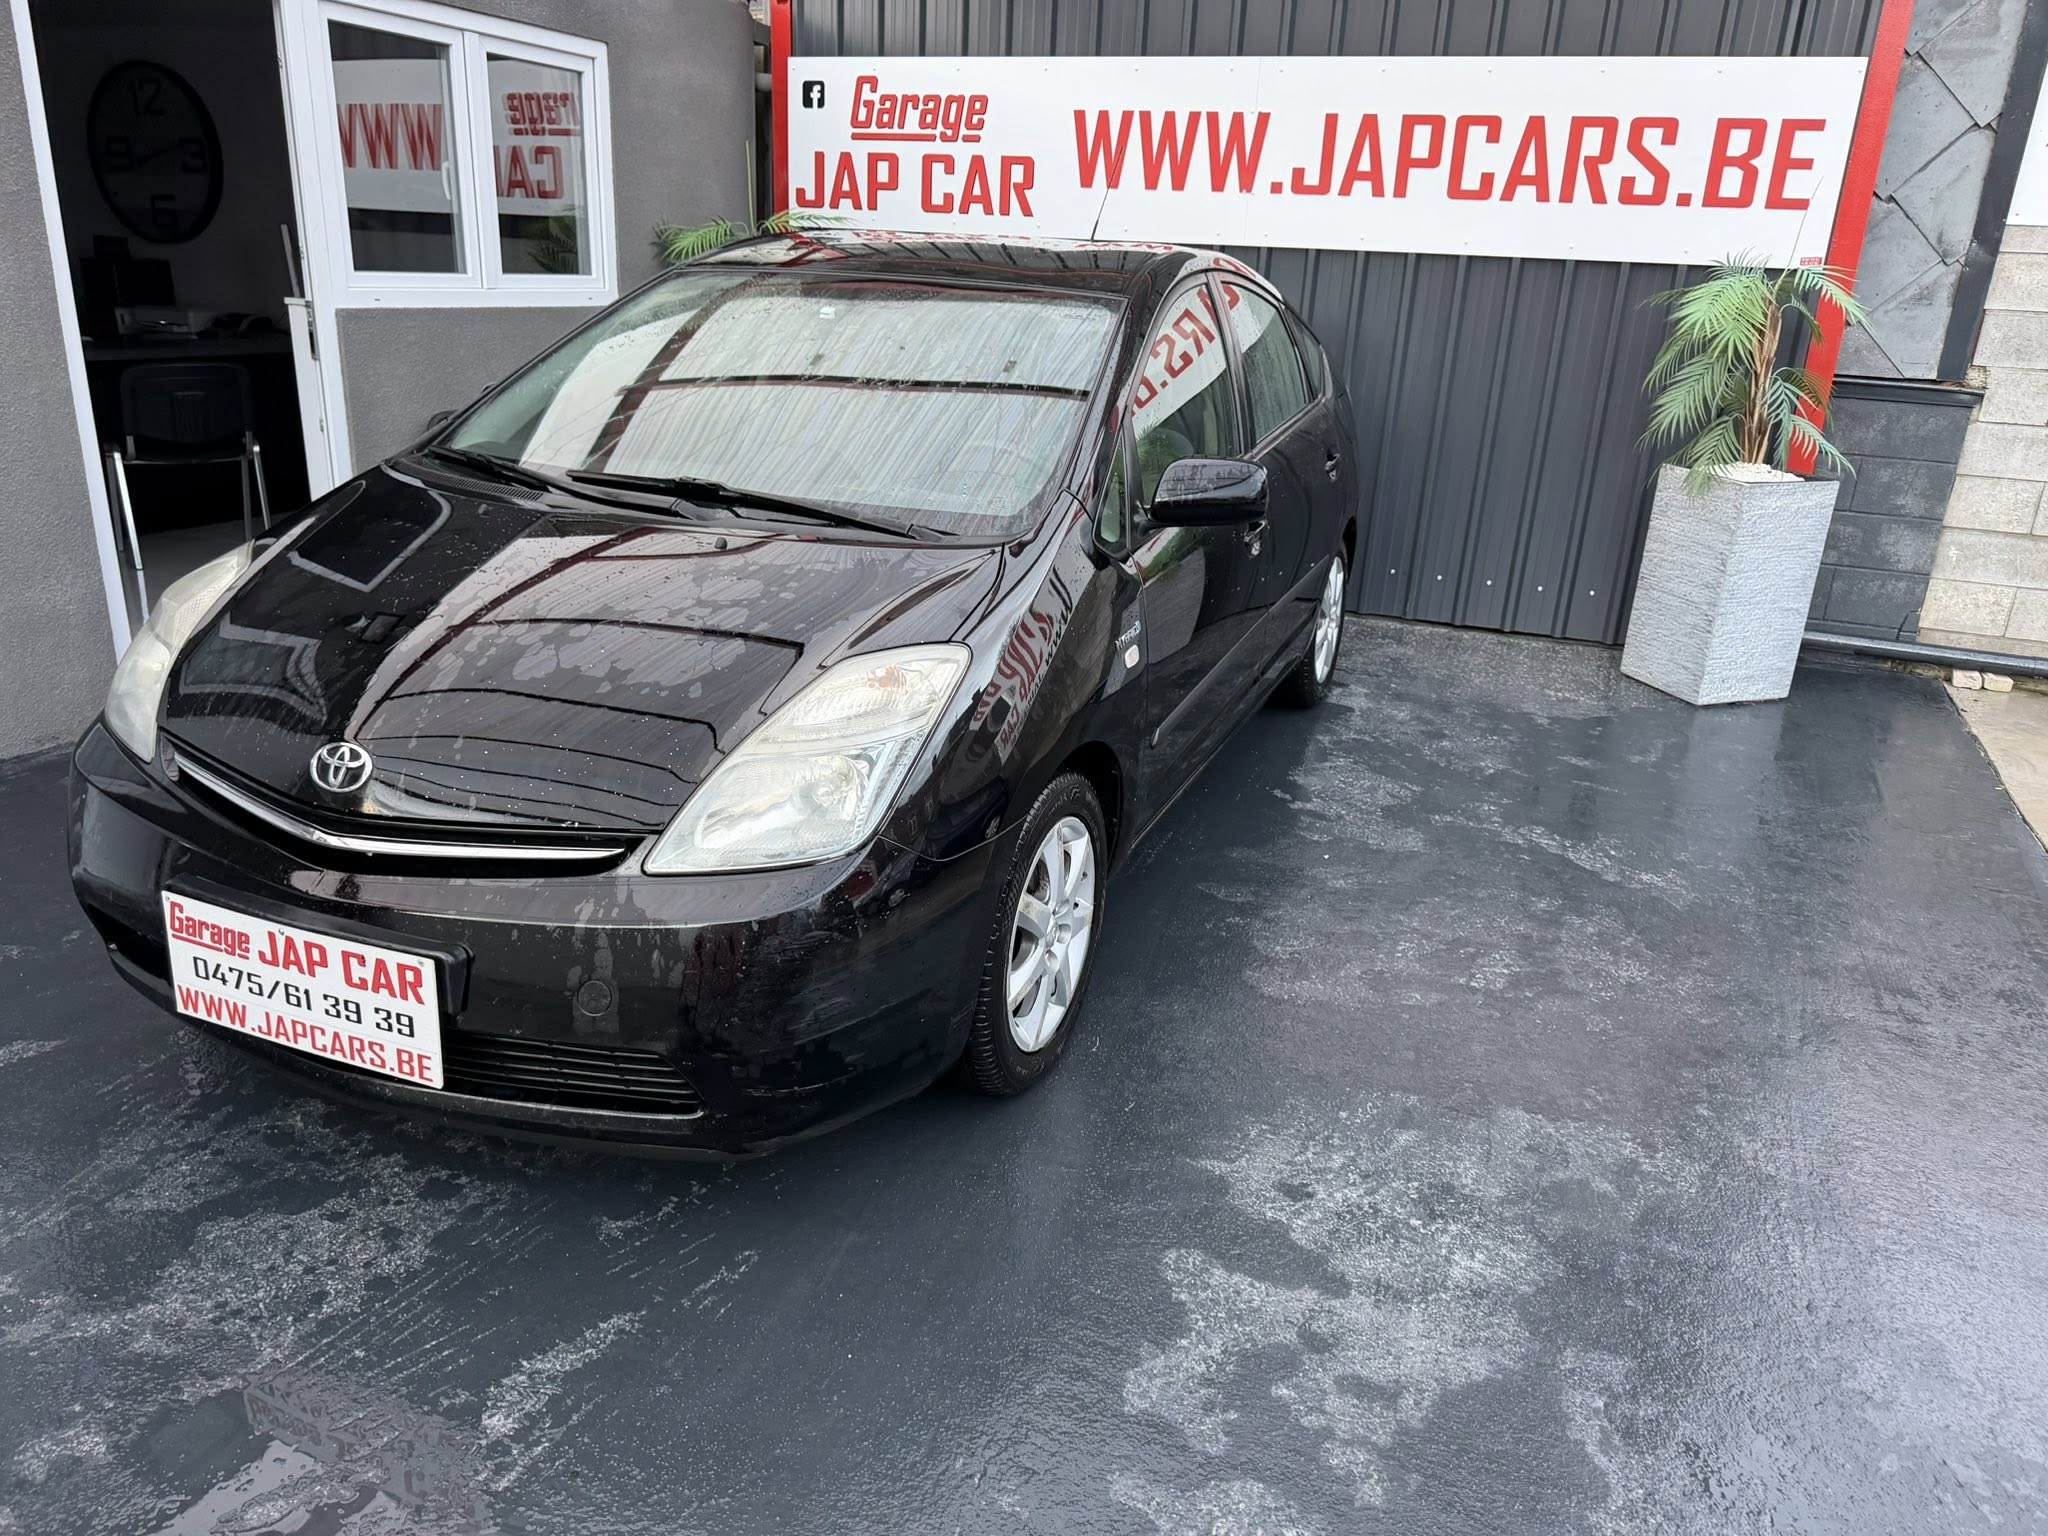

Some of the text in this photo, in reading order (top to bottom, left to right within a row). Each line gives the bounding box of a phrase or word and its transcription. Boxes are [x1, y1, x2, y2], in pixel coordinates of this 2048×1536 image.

[127, 78, 164, 116] 12
[850, 75, 989, 142] Garage
[104, 136, 134, 173] 9
[179, 136, 208, 174] 3
[795, 151, 1035, 217] JAP CAR
[1073, 109, 1827, 211] WWW.JAPCARS.BE
[150, 194, 179, 228] 6
[169, 901, 426, 1005] Garage JAP CAR
[192, 956, 415, 1038] 0475/61 39 39
[177, 984, 434, 1083] WWW.JAPCARS.BE
